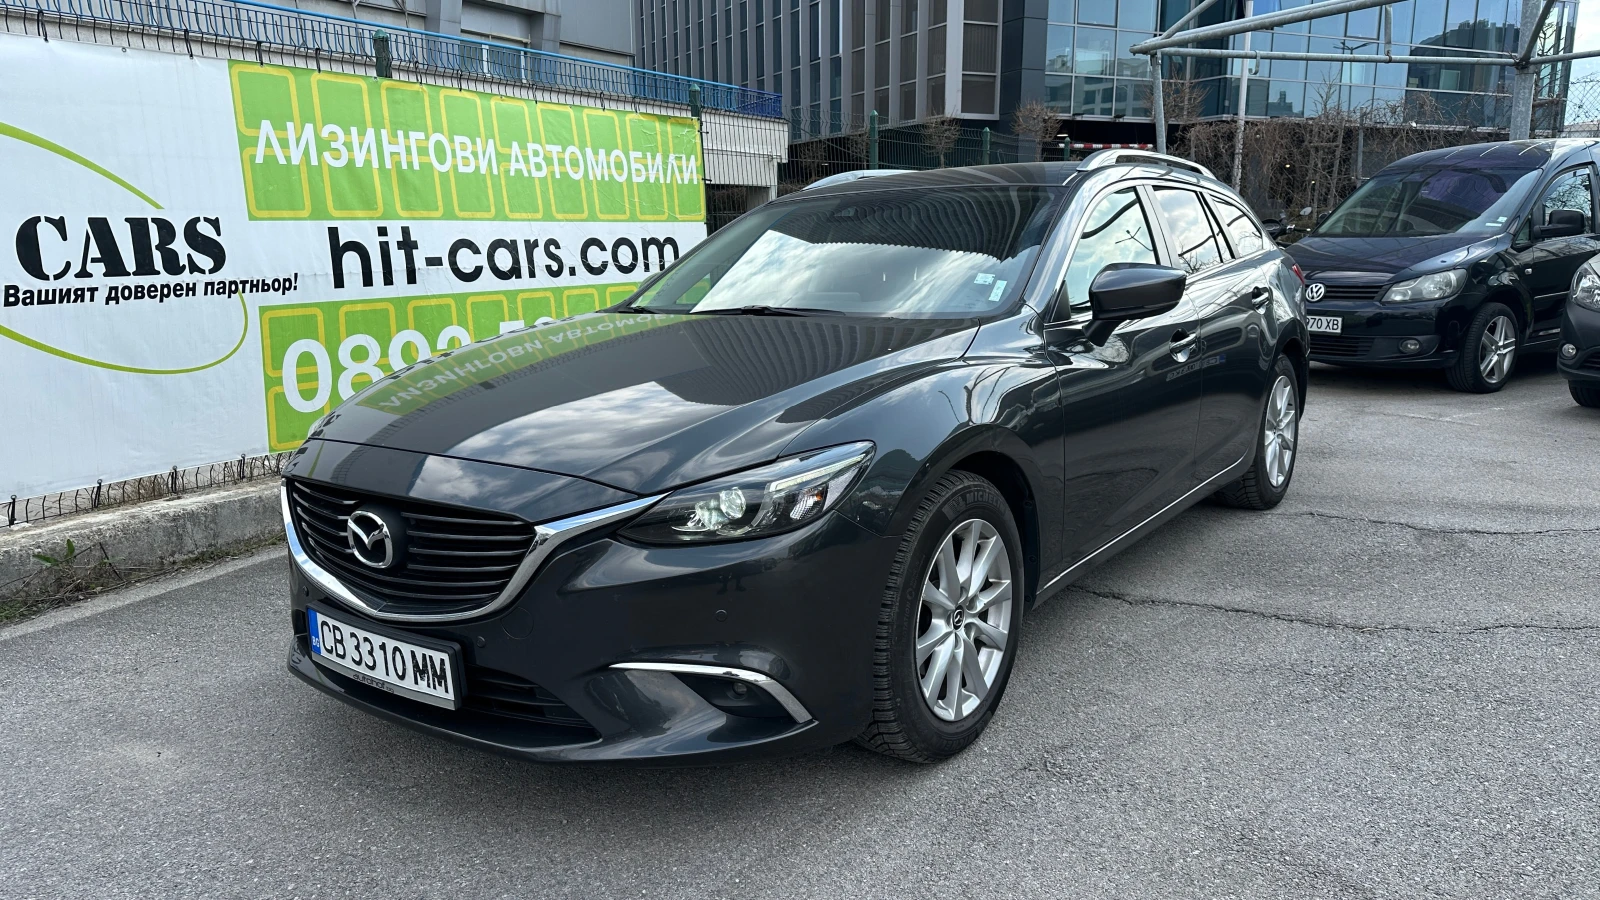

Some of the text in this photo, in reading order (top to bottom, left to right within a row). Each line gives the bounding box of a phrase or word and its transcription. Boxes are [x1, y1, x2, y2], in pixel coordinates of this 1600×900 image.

[255, 119, 698, 185] ЛИЗИНГОВИ АВТОМОБИЛИ
[15, 215, 227, 281] CARS
[327, 225, 680, 289] hit-cars.com
[3, 272, 299, 307] Вашият доверен партньор!
[1325, 318, 1339, 331] XB
[312, 635, 320, 648] BG
[320, 620, 449, 694] CB 3310 MM
